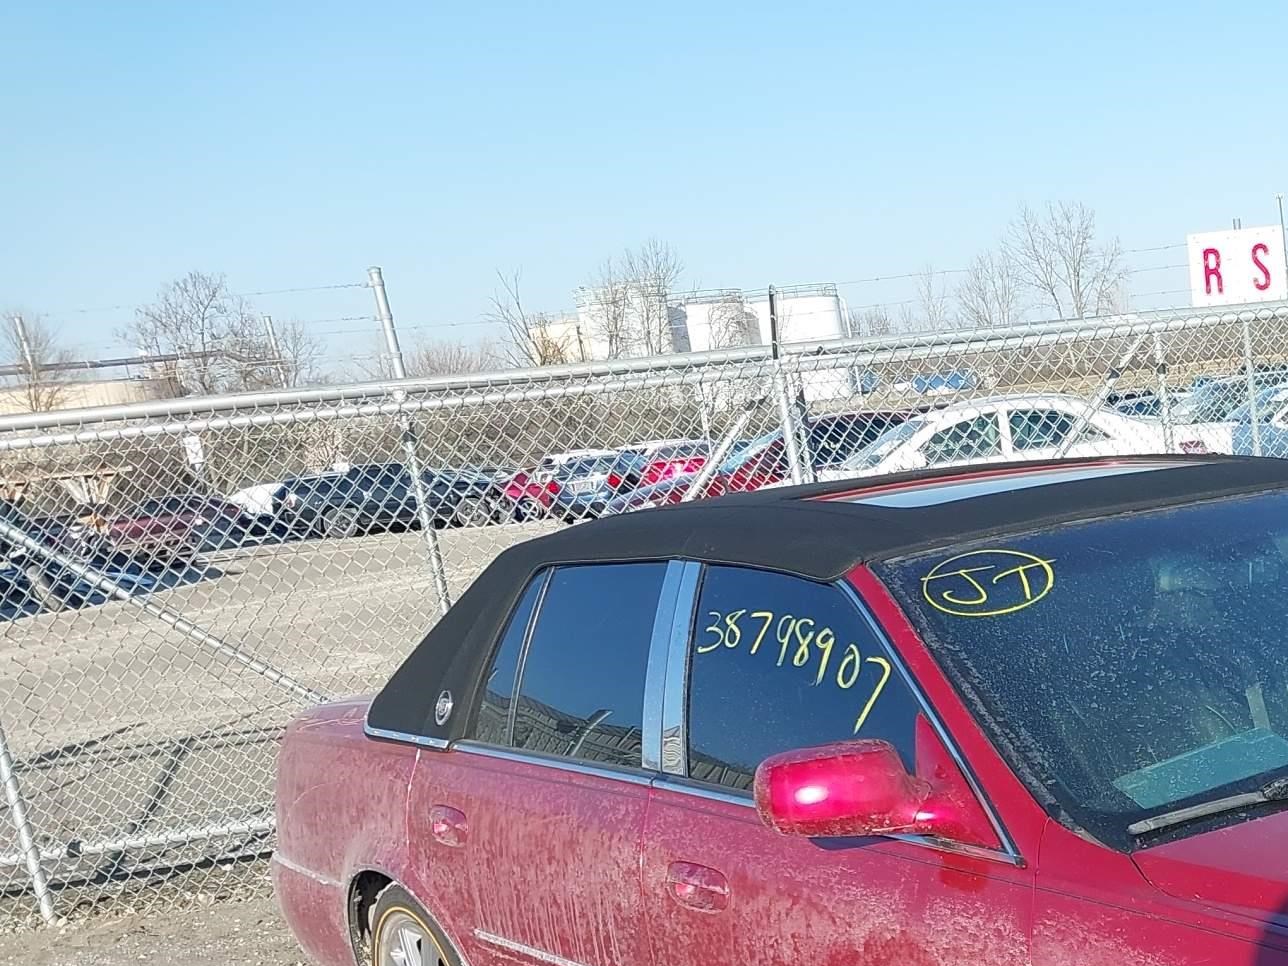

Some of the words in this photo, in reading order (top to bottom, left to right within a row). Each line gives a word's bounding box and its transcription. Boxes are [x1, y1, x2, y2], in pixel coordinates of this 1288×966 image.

[1203, 247, 1223, 294] R
[1251, 243, 1271, 291] S
[697, 608, 892, 736] 38798907
